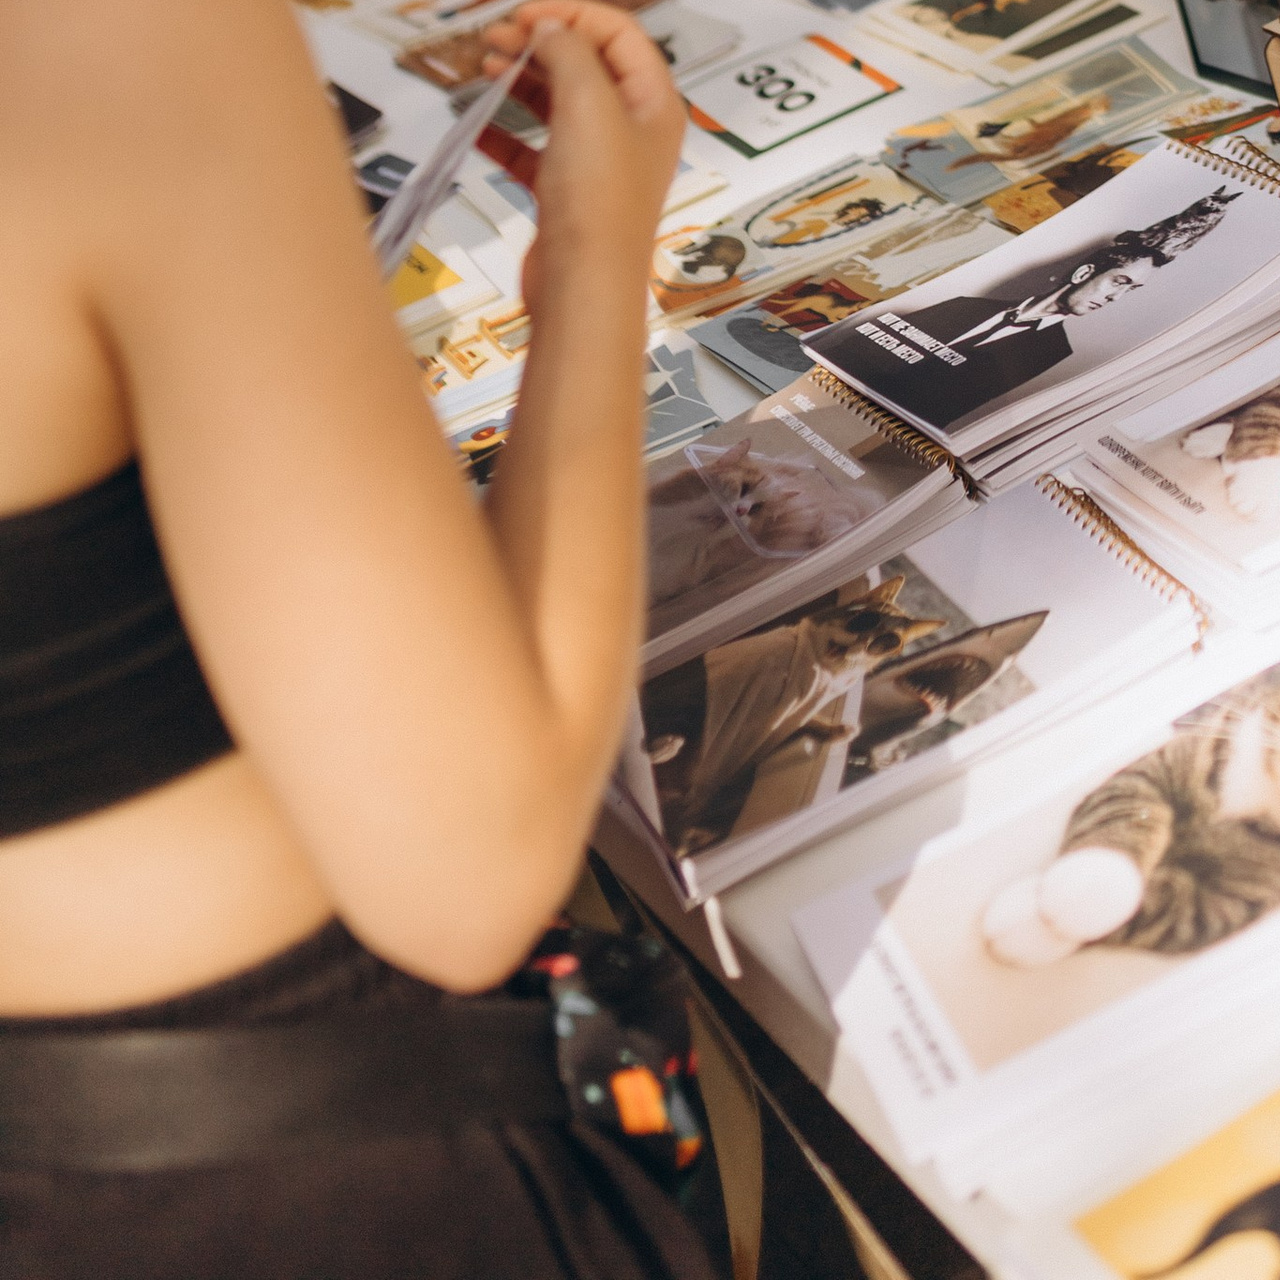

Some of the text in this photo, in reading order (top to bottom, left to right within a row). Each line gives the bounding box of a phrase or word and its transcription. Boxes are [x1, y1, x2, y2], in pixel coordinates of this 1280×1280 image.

[736, 64, 816, 112] 300
[855, 321, 880, 337] КОТ
[874, 332, 901, 351] ЕСТЬ
[891, 343, 924, 365] МЕСТО
[877, 312, 967, 366] КОТ НЕ ЗАНИМАЕТ МЕСТО
